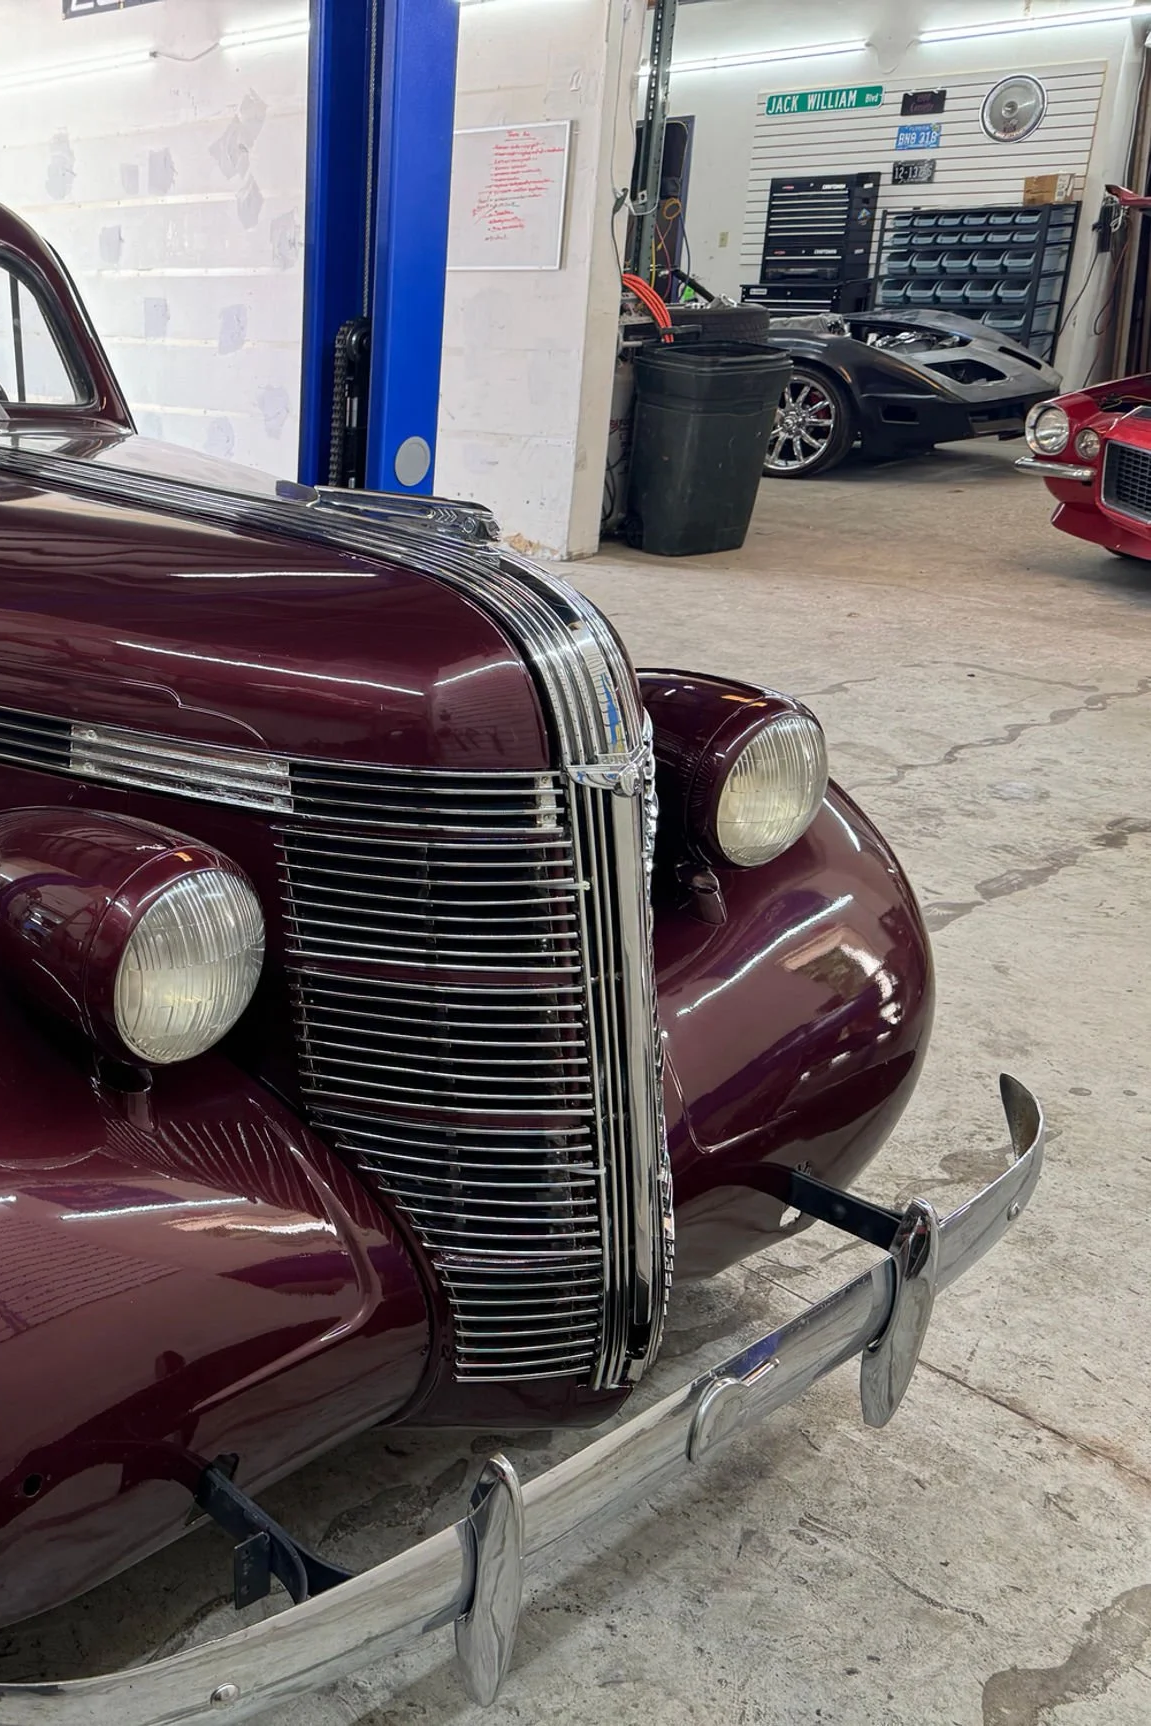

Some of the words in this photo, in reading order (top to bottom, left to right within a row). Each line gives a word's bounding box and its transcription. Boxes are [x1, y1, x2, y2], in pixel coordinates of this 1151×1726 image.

[768, 95, 799, 114] JACK
[807, 90, 858, 111] WILLIAM
[865, 93, 879, 104] Blvd
